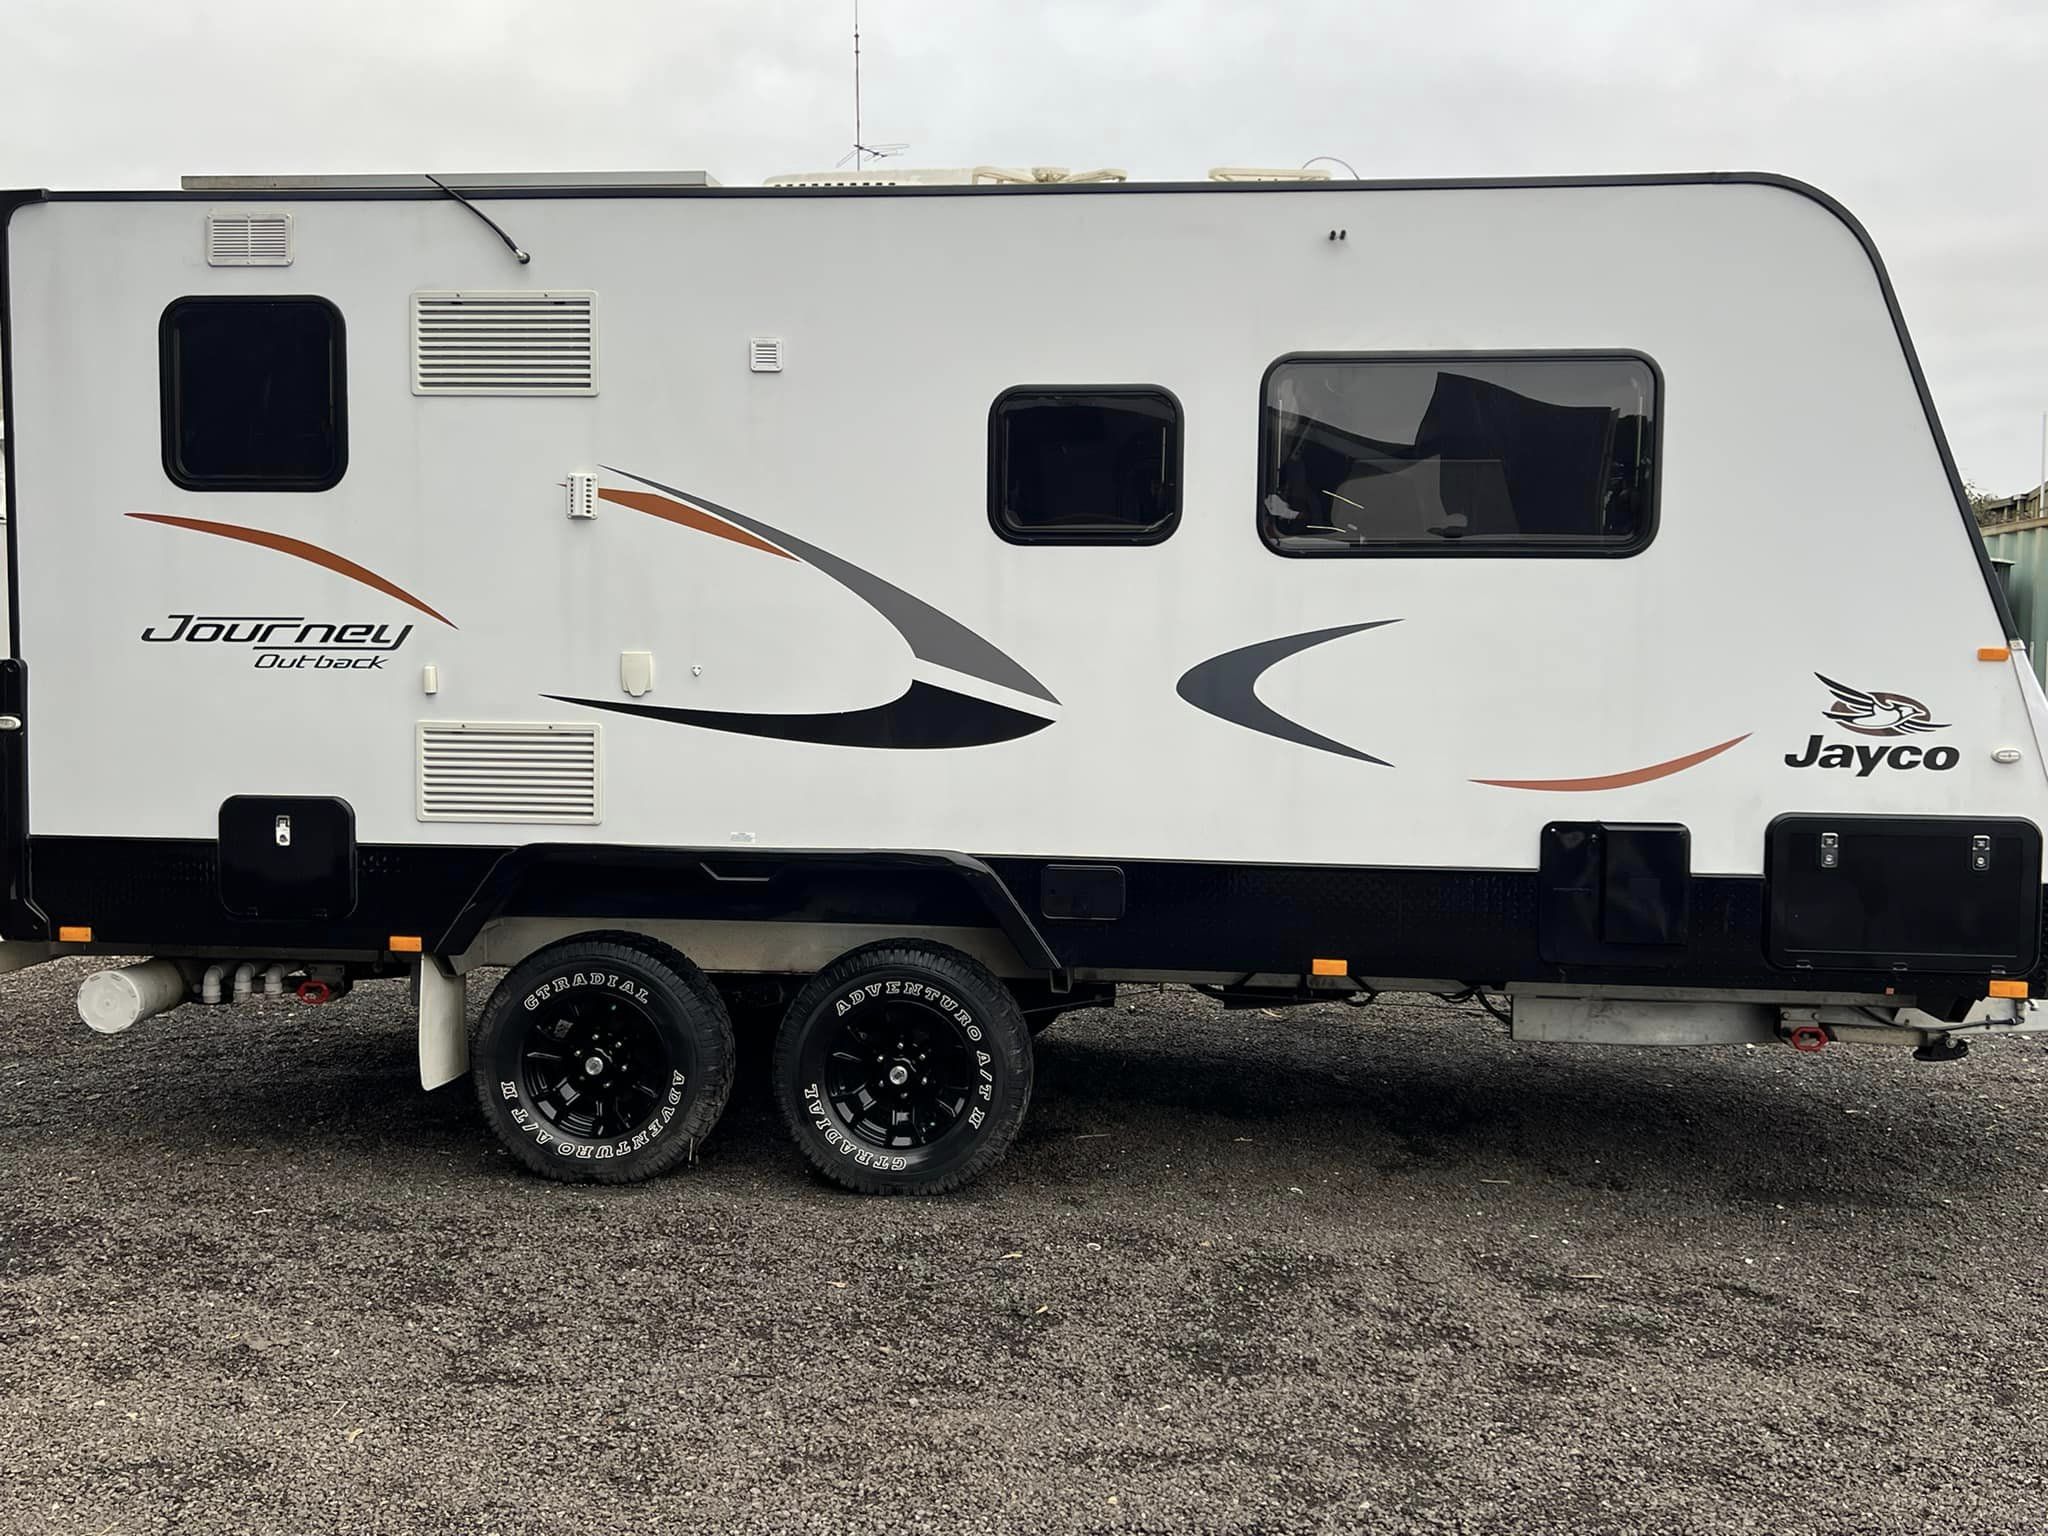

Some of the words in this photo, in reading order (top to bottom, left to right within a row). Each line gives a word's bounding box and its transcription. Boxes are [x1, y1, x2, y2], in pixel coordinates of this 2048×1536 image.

[140, 614, 413, 651] Journey
[253, 653, 390, 670] Outback
[1784, 734, 1961, 778] Jayco
[834, 981, 982, 1042] ADVENTURO
[976, 1050, 992, 1101] A/T
[511, 1108, 554, 1145] A/T
[557, 1069, 686, 1160] ADVENTURO
